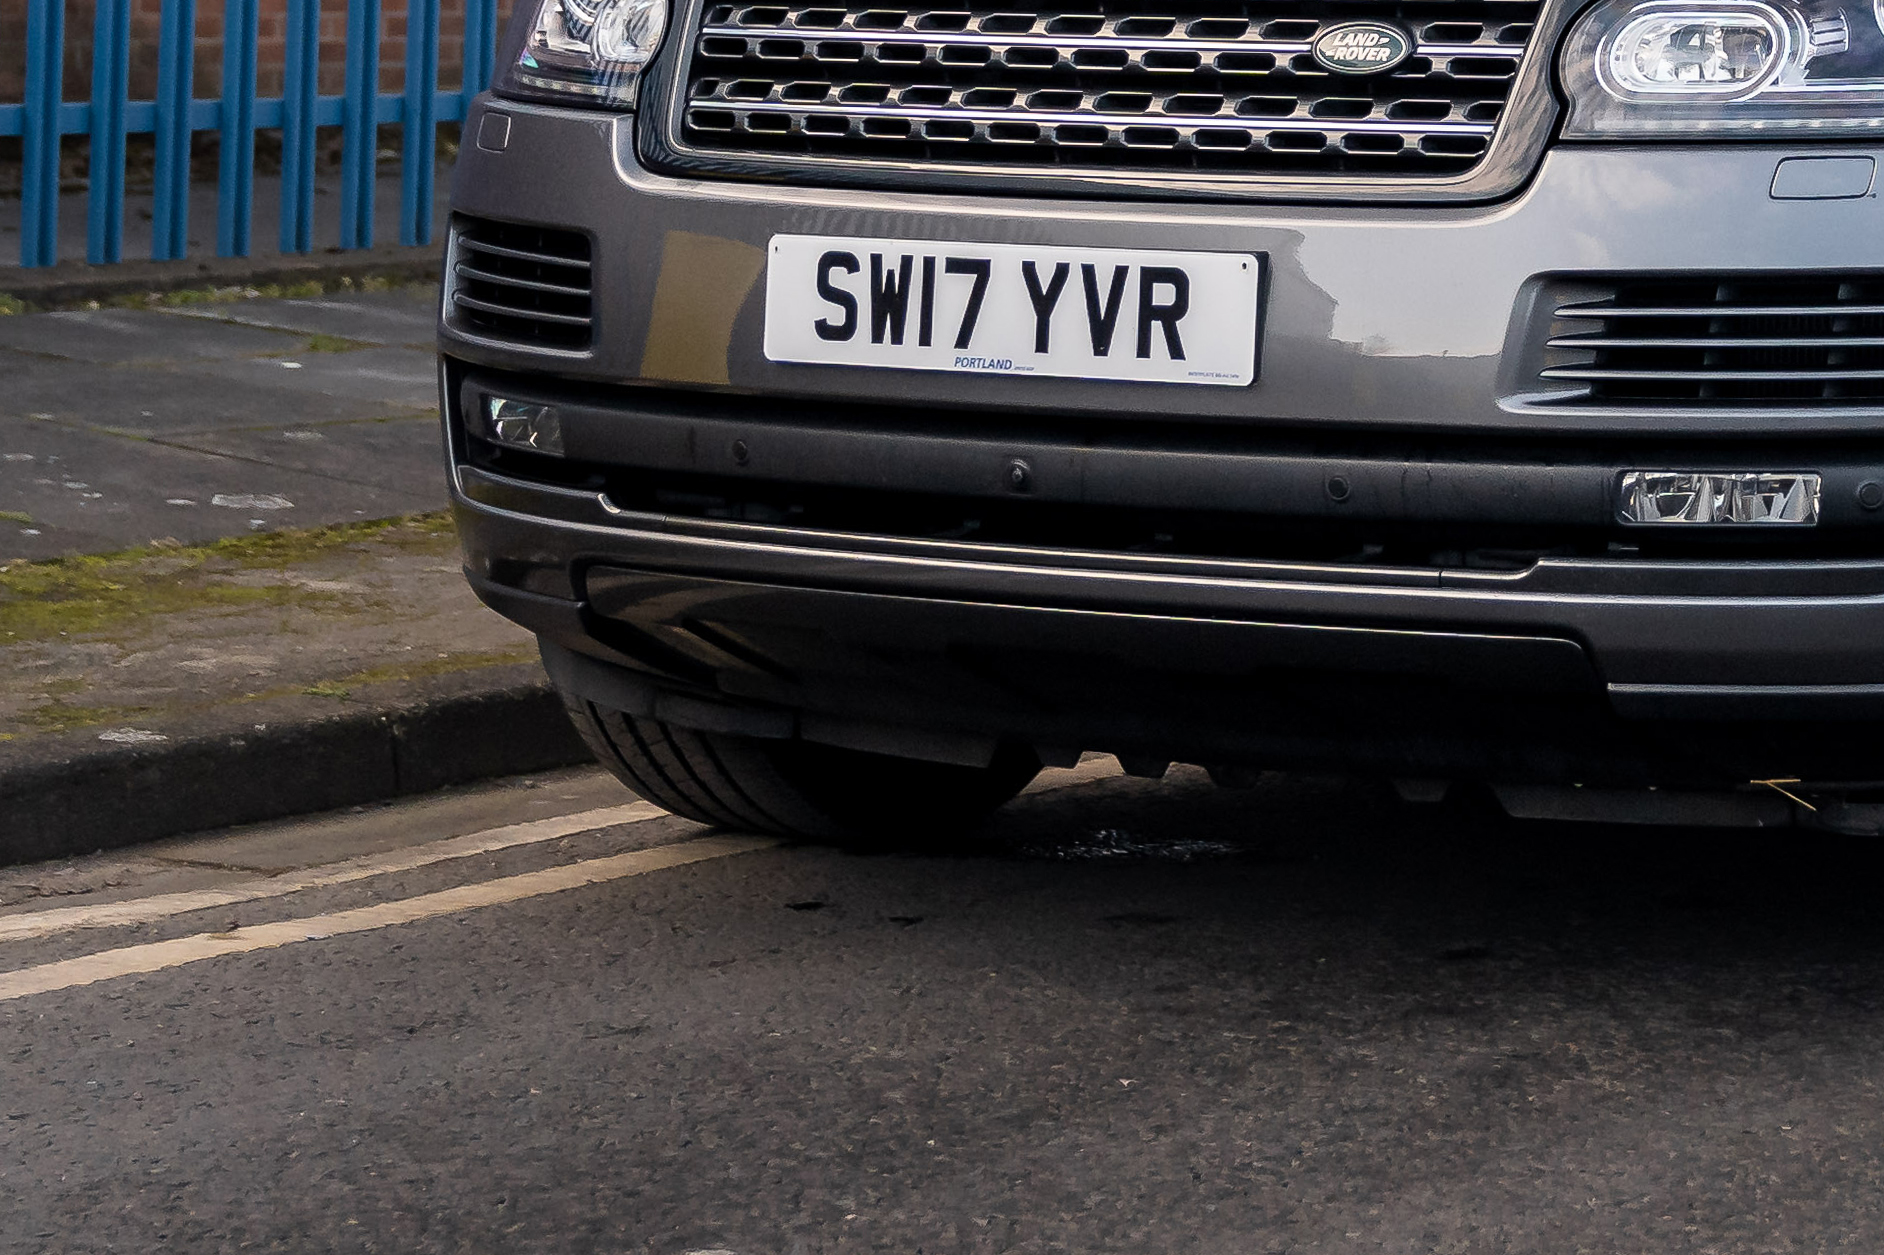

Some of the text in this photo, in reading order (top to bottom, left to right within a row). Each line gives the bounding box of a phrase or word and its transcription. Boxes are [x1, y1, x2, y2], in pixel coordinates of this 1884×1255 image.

[1333, 32, 1379, 46] LAND
[1335, 46, 1391, 61] ROVER
[814, 250, 1191, 362] SW17 YVR
[954, 357, 1012, 370] PORTLAND
